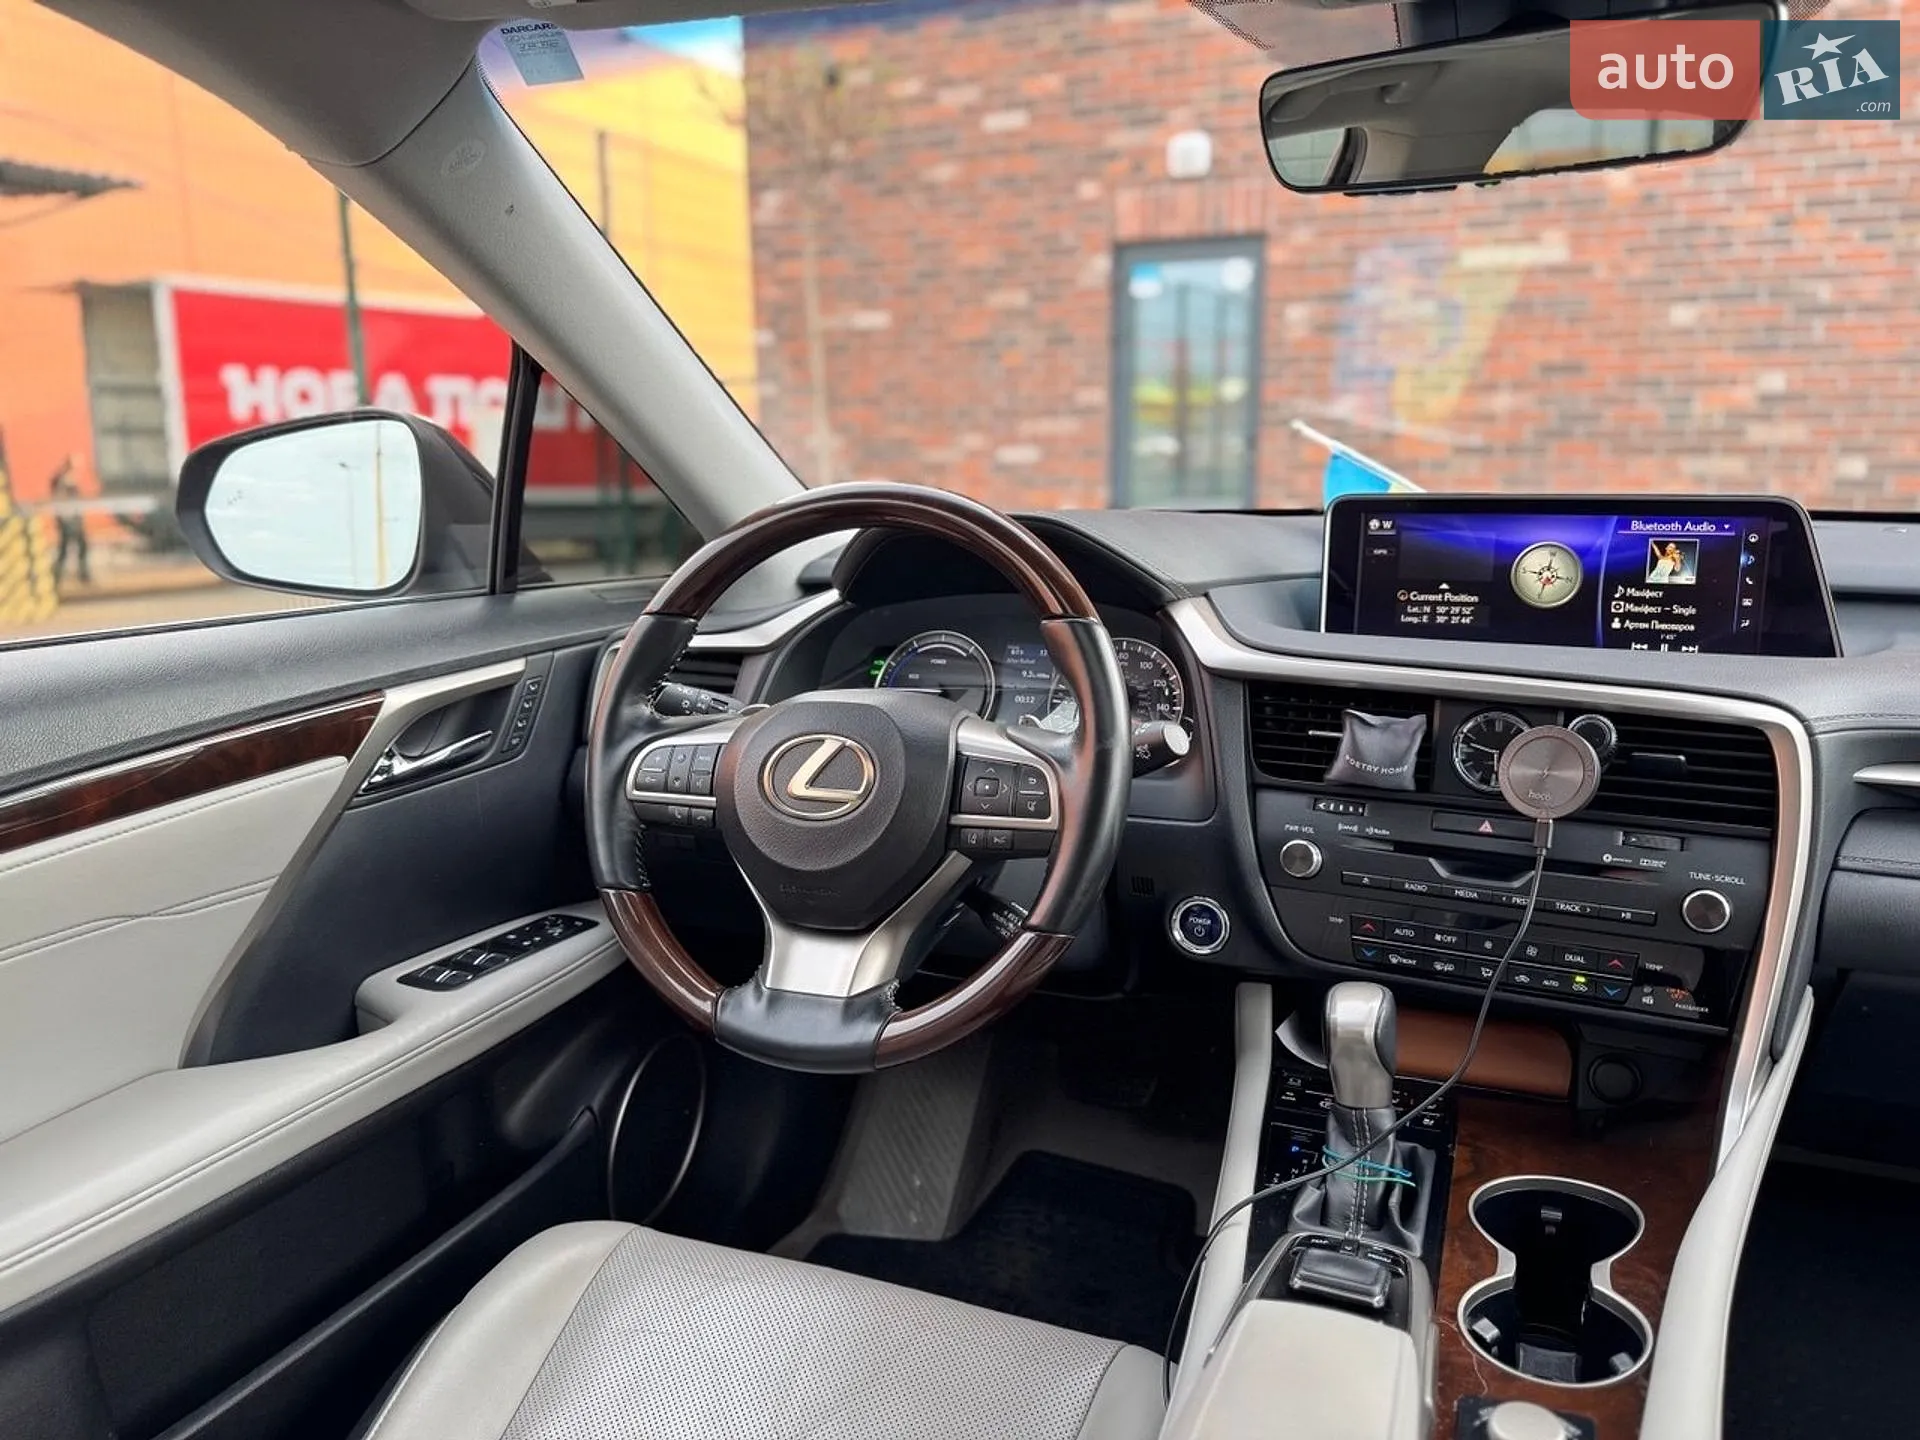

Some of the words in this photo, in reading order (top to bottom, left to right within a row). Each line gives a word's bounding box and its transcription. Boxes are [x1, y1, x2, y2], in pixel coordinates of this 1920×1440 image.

[1630, 520, 1682, 531] Bluetooth
[1684, 521, 1716, 532] Audio
[1410, 591, 1443, 602] Current
[1444, 592, 1479, 603] Position
[1672, 604, 1697, 617] Single
[1140, 661, 1153, 670] 100
[1153, 679, 1167, 688] 120
[1156, 703, 1170, 712] 140
[1404, 882, 1428, 892] RADIO
[1454, 889, 1479, 899] MEDIA
[1555, 902, 1581, 912] TRACK
[1188, 916, 1212, 925] POWER
[1393, 928, 1415, 938] AUTO
[1564, 953, 1586, 964] DUAL
